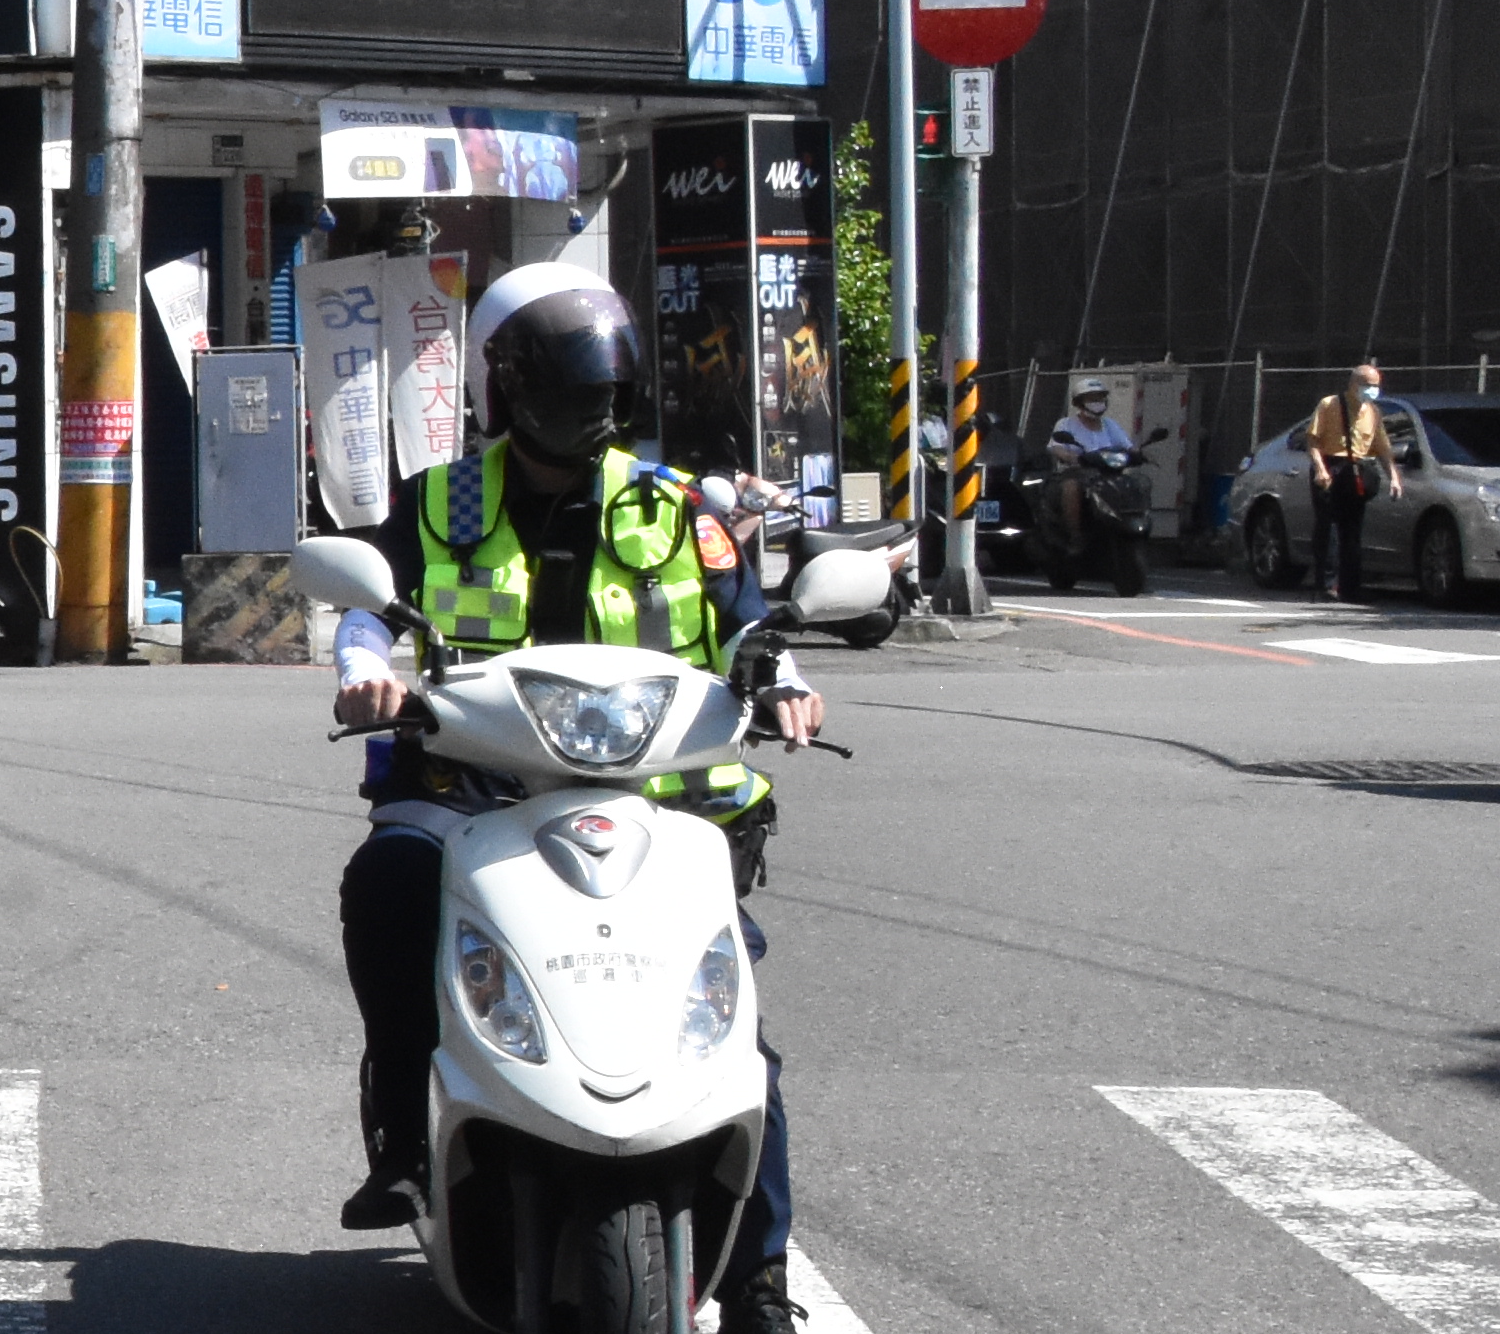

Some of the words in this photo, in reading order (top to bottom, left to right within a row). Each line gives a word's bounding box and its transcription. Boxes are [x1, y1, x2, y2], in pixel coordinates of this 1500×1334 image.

[705, 22, 811, 66] 中華電信
[339, 109, 379, 125] Galaxy
[963, 77, 981, 147] 禁止進入
[658, 291, 699, 313] OUT
[760, 284, 797, 308] OUT
